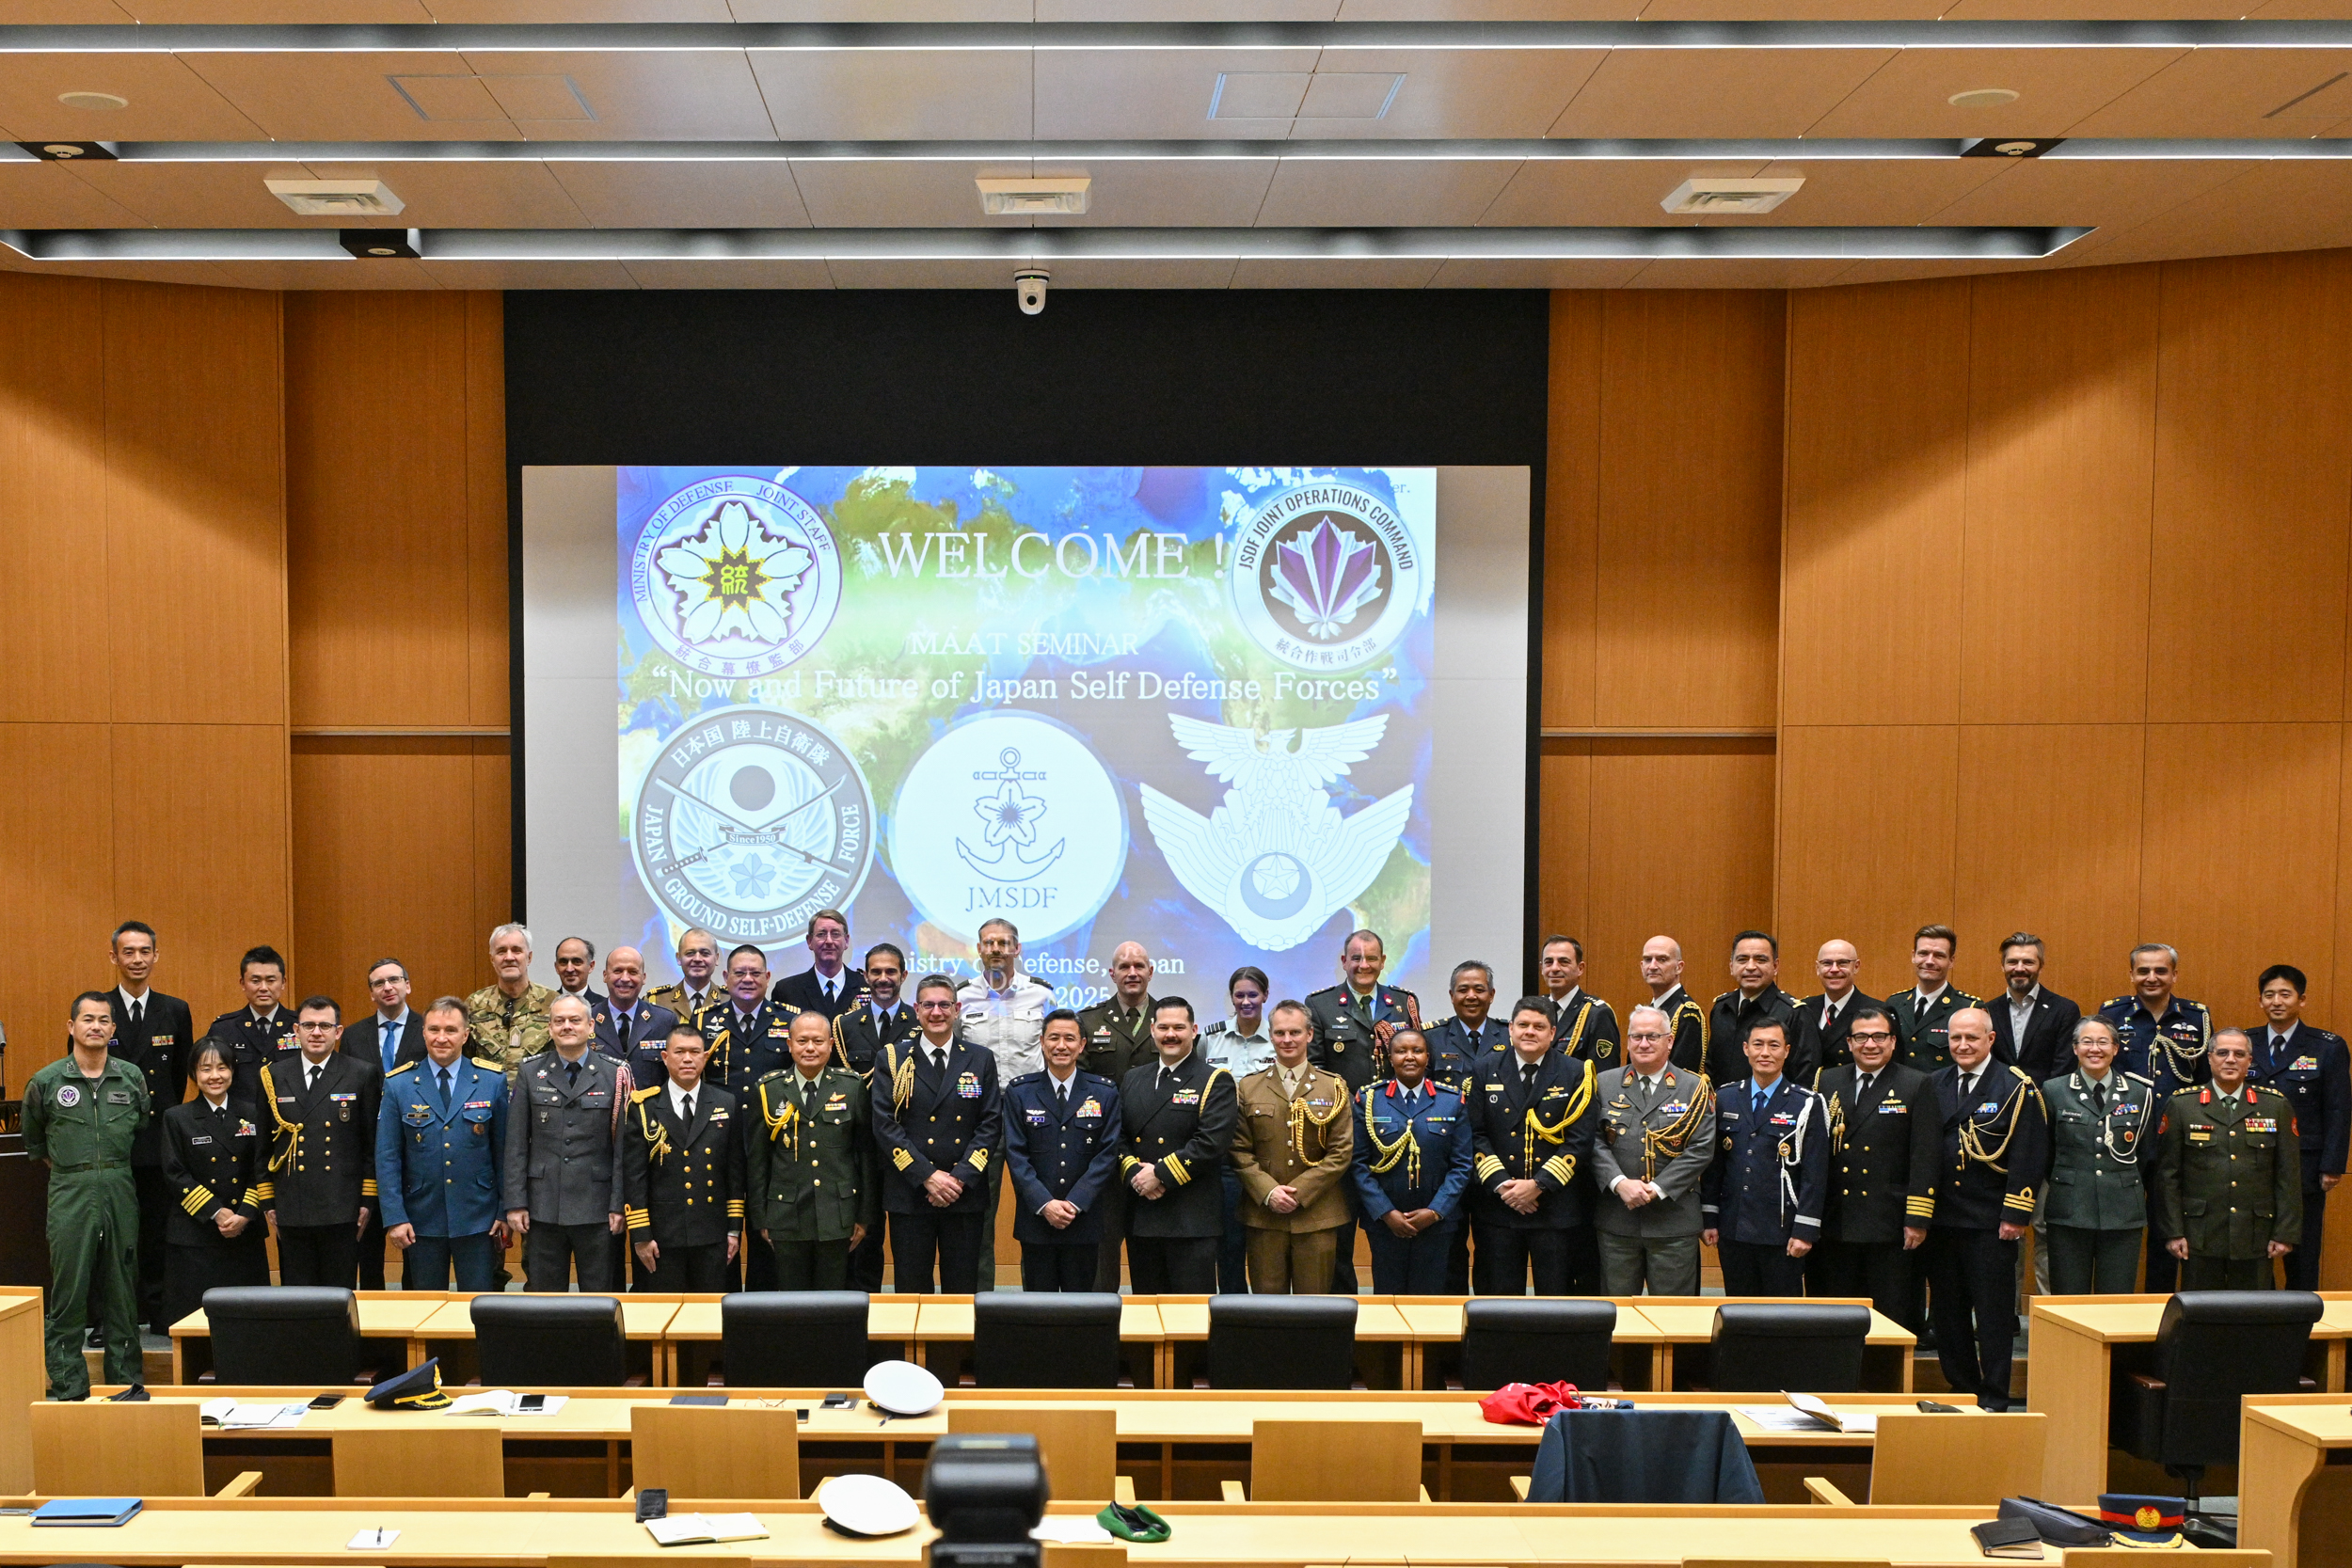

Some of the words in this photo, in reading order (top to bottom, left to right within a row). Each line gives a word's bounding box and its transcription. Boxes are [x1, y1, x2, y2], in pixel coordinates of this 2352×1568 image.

[633, 531, 656, 602] MINISTRY
[652, 512, 669, 531] OF
[667, 481, 734, 515] DEFENSE
[756, 484, 799, 511] JOINT
[796, 509, 831, 551] STAFF
[1239, 537, 1261, 570] JSDF
[1252, 503, 1285, 540] JOINT
[1285, 488, 1370, 513] OPERATIONS
[1369, 506, 1413, 571] COMMAND
[878, 531, 1189, 579] WELCOME
[910, 632, 1009, 656] MAAT
[1017, 632, 1139, 656] SEMINAR
[747, 670, 802, 699] and
[814, 671, 919, 699] Future
[930, 671, 964, 699] of
[970, 671, 1058, 704] Japan
[1071, 671, 1131, 700] Self
[1137, 671, 1262, 700] Defense
[645, 804, 667, 863] JAPAN
[665, 878, 727, 934] GROUND
[728, 879, 840, 937] SELF-DEFENSE
[838, 804, 860, 863] FORCE
[965, 887, 1058, 912] JMSDF
[1055, 986, 1112, 1007] 2025
